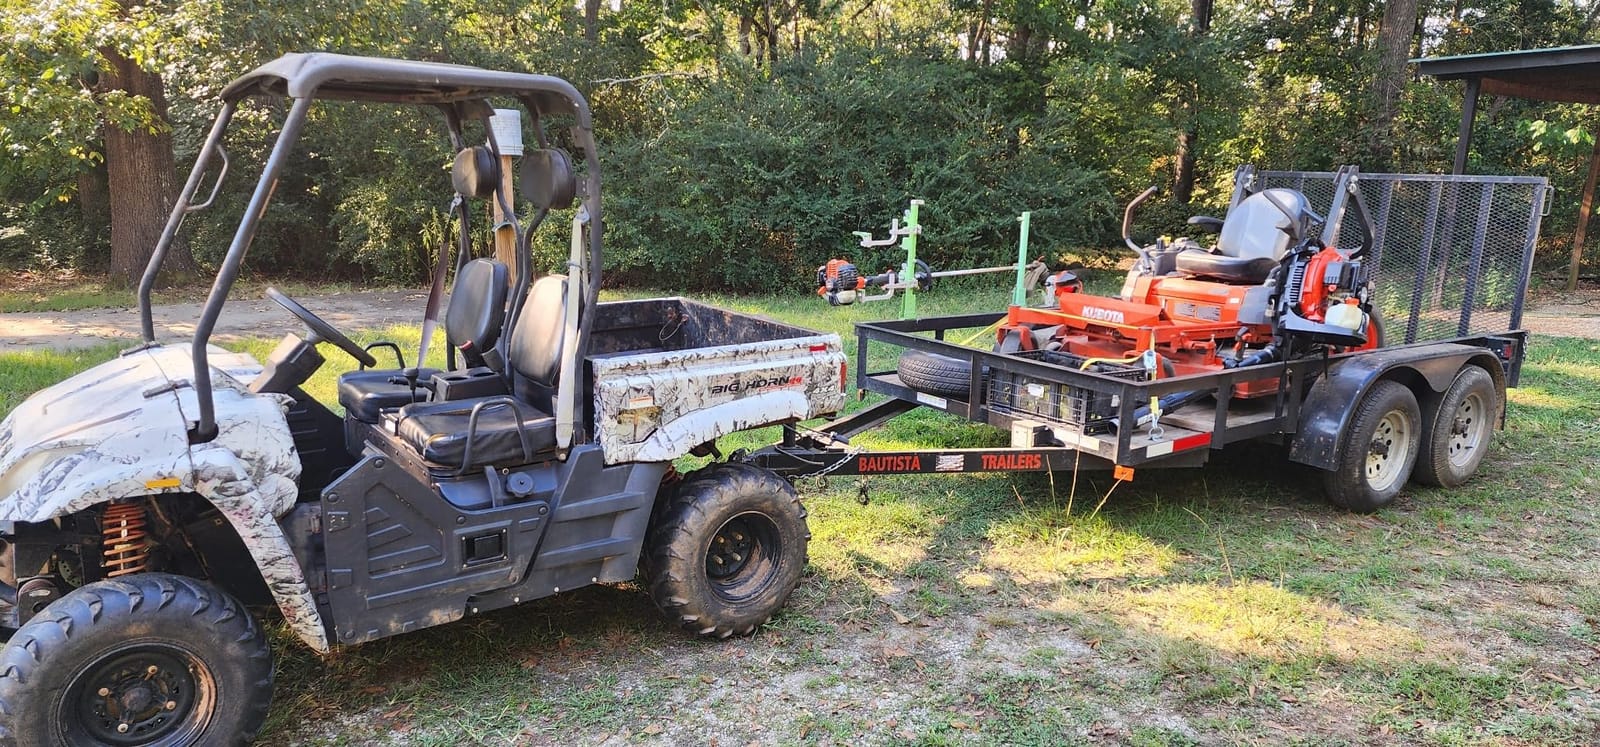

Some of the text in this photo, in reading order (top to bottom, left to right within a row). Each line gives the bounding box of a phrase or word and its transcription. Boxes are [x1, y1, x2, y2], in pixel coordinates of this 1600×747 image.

[1081, 305, 1125, 323] KUBOTA
[711, 381, 740, 394] BIG
[745, 376, 790, 390] HORN
[858, 453, 1042, 472] BAUTISTA TRAILERS
